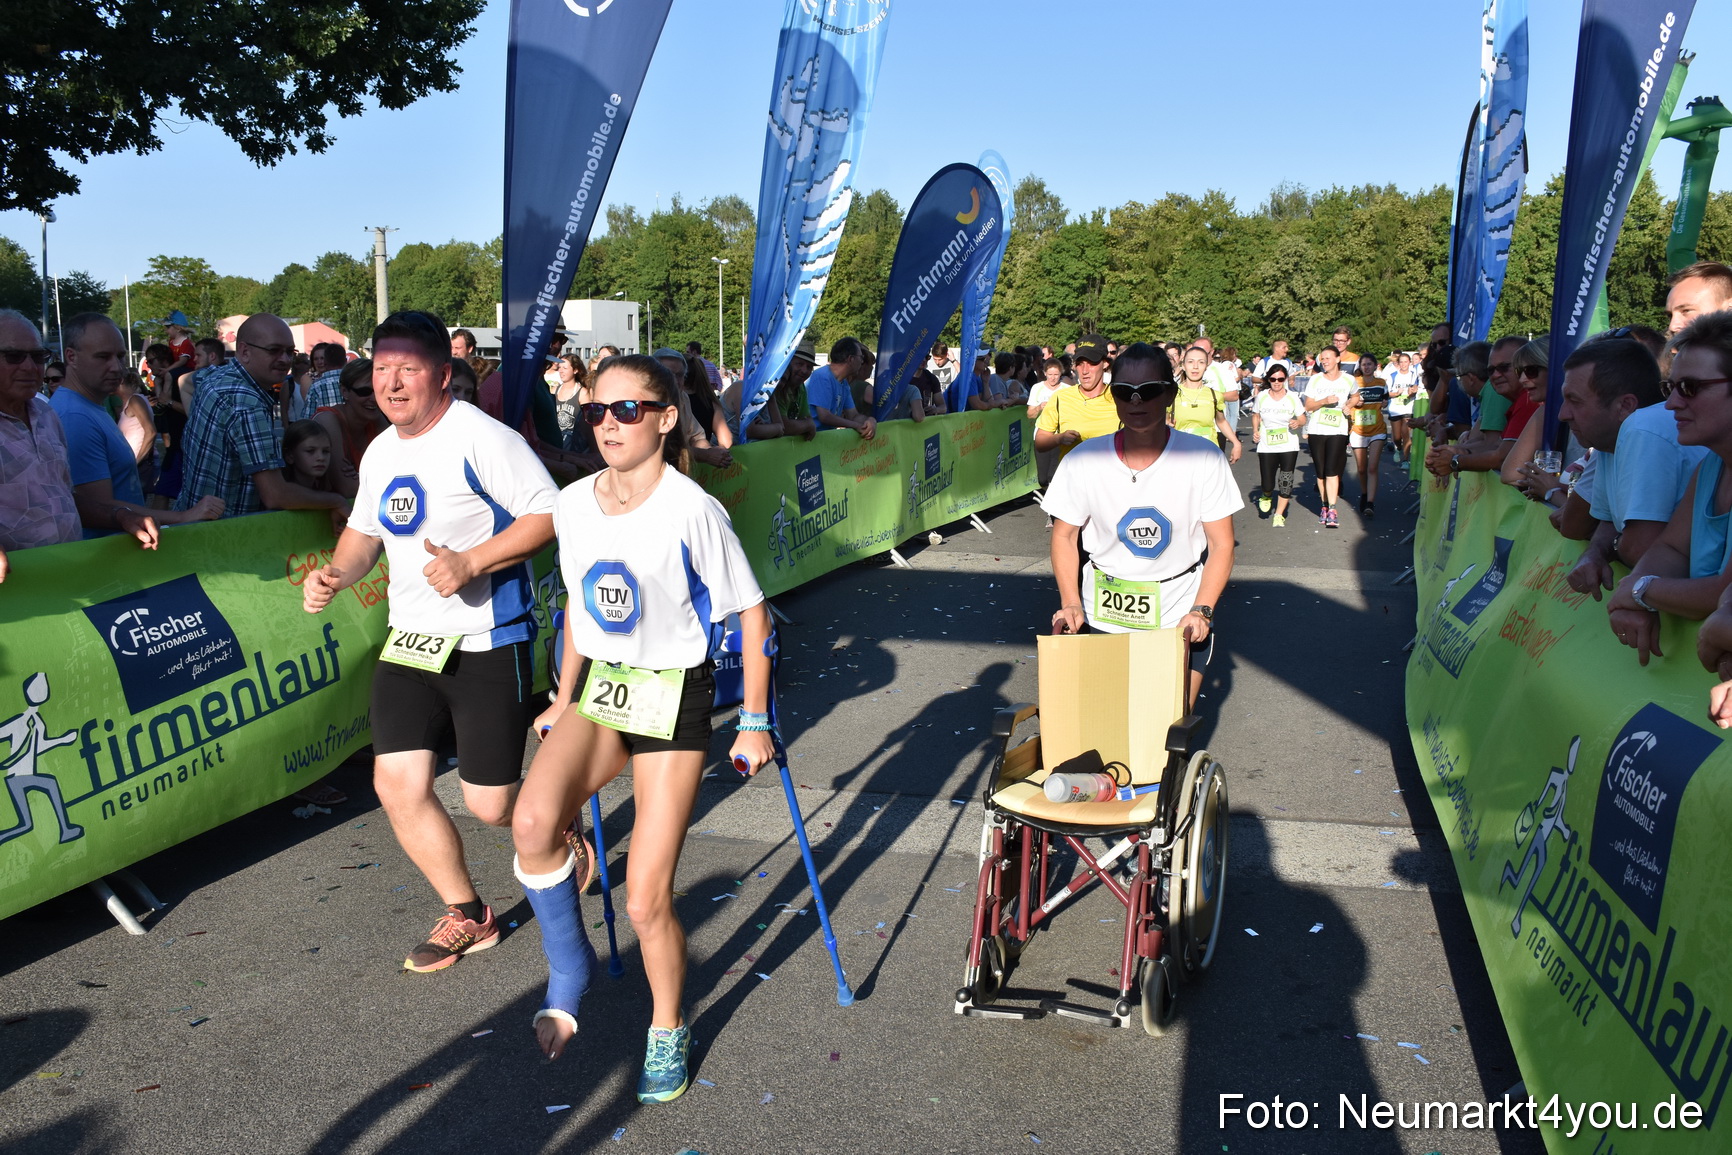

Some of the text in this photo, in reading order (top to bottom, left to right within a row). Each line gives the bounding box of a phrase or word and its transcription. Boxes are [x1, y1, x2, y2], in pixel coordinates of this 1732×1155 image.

[1566, 11, 1676, 337] www.fischer-automobile.de
[521, 93, 622, 360] www.fischer-automobile.de
[944, 217, 996, 285] Druck und Medien
[891, 229, 969, 334] Frischmann
[1324, 414, 1337, 422] 705
[802, 473, 819, 488] Fischer
[391, 497, 414, 512] TÜV
[791, 488, 848, 548] firmenlauf
[395, 514, 409, 523] SÜD
[1129, 527, 1158, 538] TÜV
[598, 586, 628, 605] TÜV
[1102, 589, 1150, 614] 2025
[606, 608, 623, 619] SÜD
[1107, 609, 1130, 618] Schneider
[129, 611, 204, 648] Fischer
[147, 627, 208, 657] AUTOMOBILE
[393, 630, 446, 655] 2023
[185, 650, 200, 664] das
[192, 647, 233, 680] fährt mit!
[395, 648, 418, 657] Schneider
[593, 680, 632, 711] 20
[80, 622, 341, 797] firmenlauf
[590, 710, 600, 718] TÜV
[597, 707, 631, 719] Schneide
[101, 742, 226, 821] neumarkt
[1614, 754, 1668, 814] Fischer
[1613, 793, 1656, 834] AUTOMOBILE
[1526, 925, 1599, 1028] neumarkt
